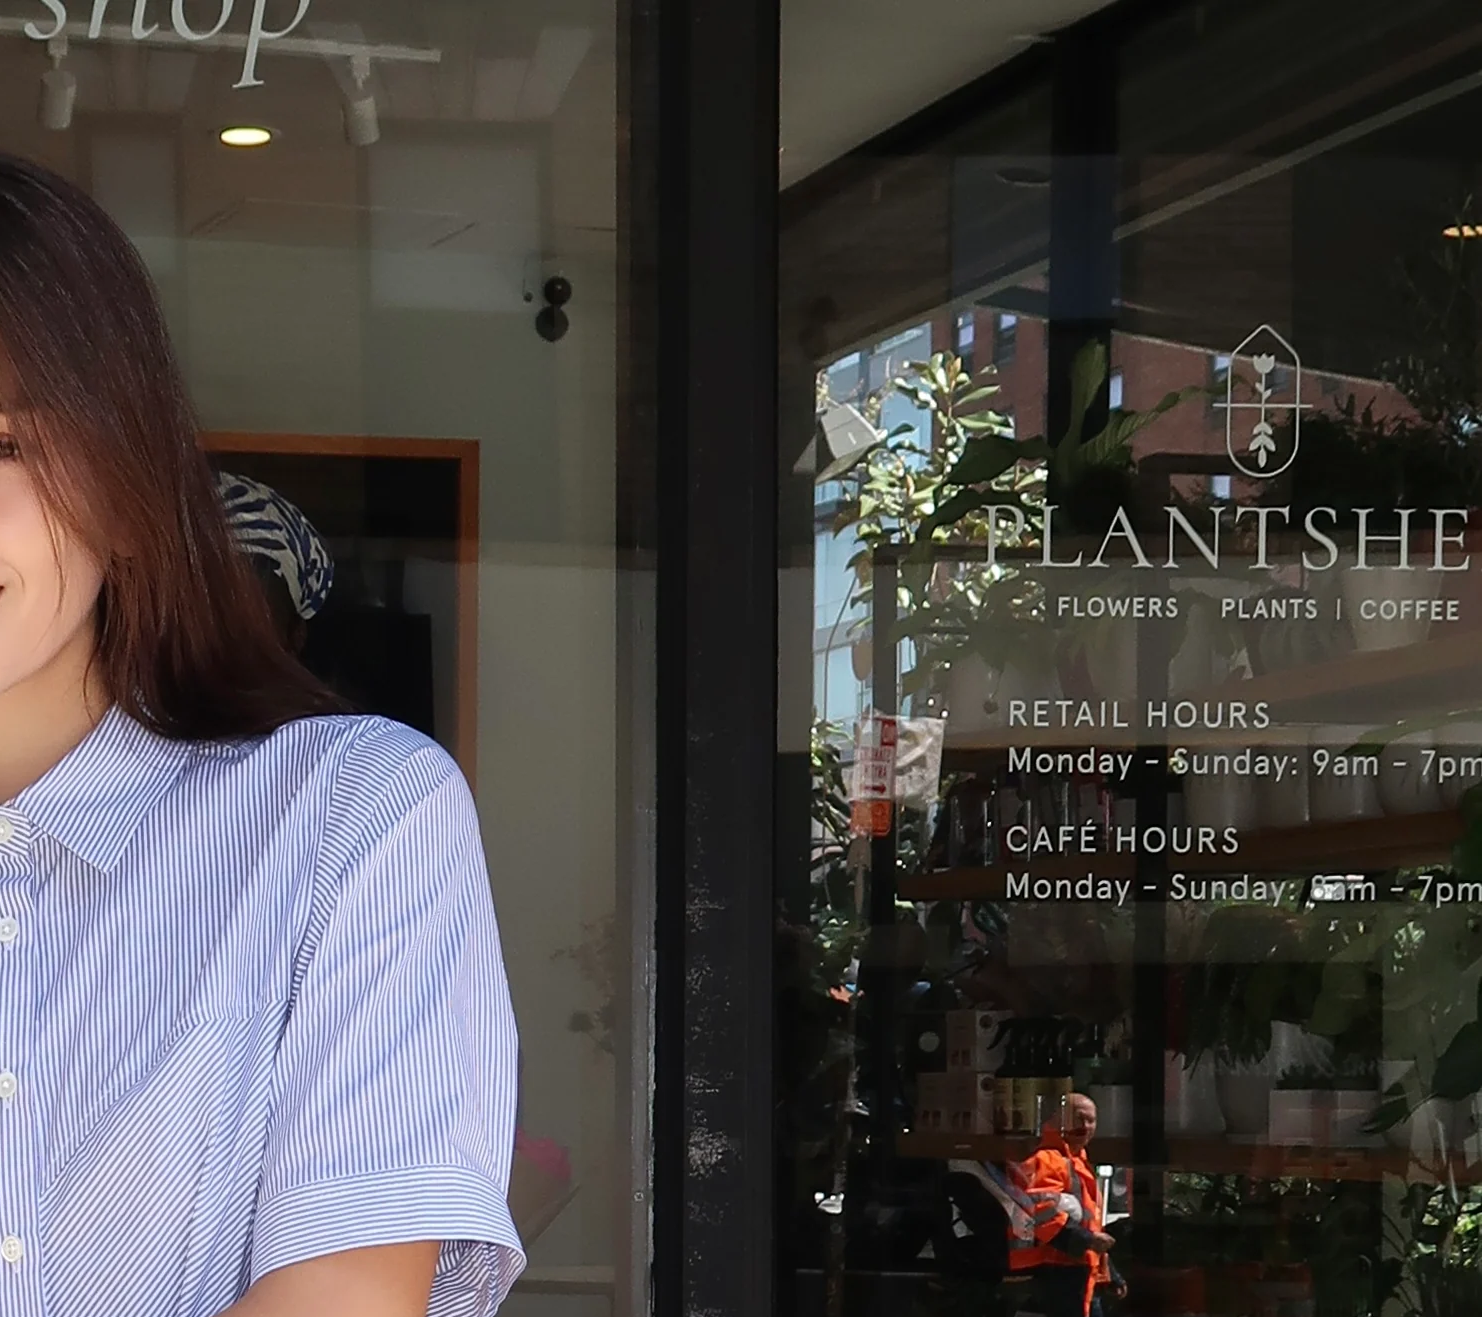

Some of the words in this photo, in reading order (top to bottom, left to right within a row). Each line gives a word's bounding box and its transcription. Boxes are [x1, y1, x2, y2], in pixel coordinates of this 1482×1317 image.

[980, 504, 1472, 572] PLANTSHE
[1057, 596, 1180, 619] FLOWERS
[1221, 598, 1319, 621] PLANTS
[1359, 599, 1461, 622] COFFEE
[1008, 700, 1130, 729] RETAIL
[1147, 701, 1271, 730] HOURS
[1008, 747, 1134, 783] Monday
[1173, 748, 1300, 784] Sunday:
[1312, 748, 1380, 777] 9am
[1421, 749, 1482, 784] 7pm
[1005, 819, 1098, 854] CAFÉ
[1116, 826, 1241, 855] HOURS
[1005, 872, 1133, 909] Monday
[1170, 873, 1298, 909] Sunday:
[1418, 875, 1482, 909] 7pm
